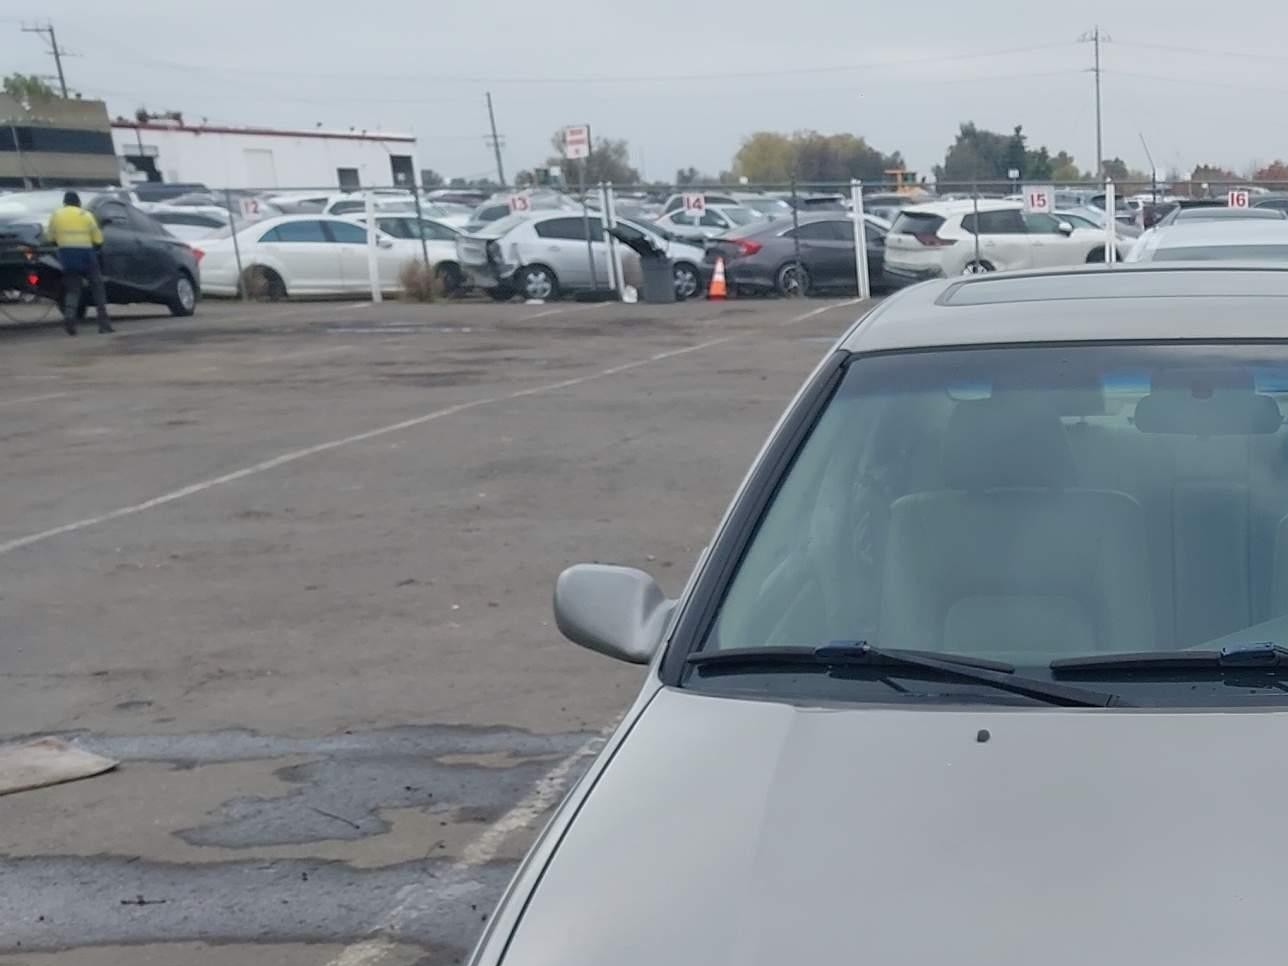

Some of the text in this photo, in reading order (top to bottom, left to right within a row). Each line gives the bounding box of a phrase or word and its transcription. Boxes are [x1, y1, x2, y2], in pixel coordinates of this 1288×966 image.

[511, 197, 529, 210] 13
[686, 197, 703, 210] 14
[1030, 193, 1046, 208] 15
[1231, 192, 1246, 207] 16
